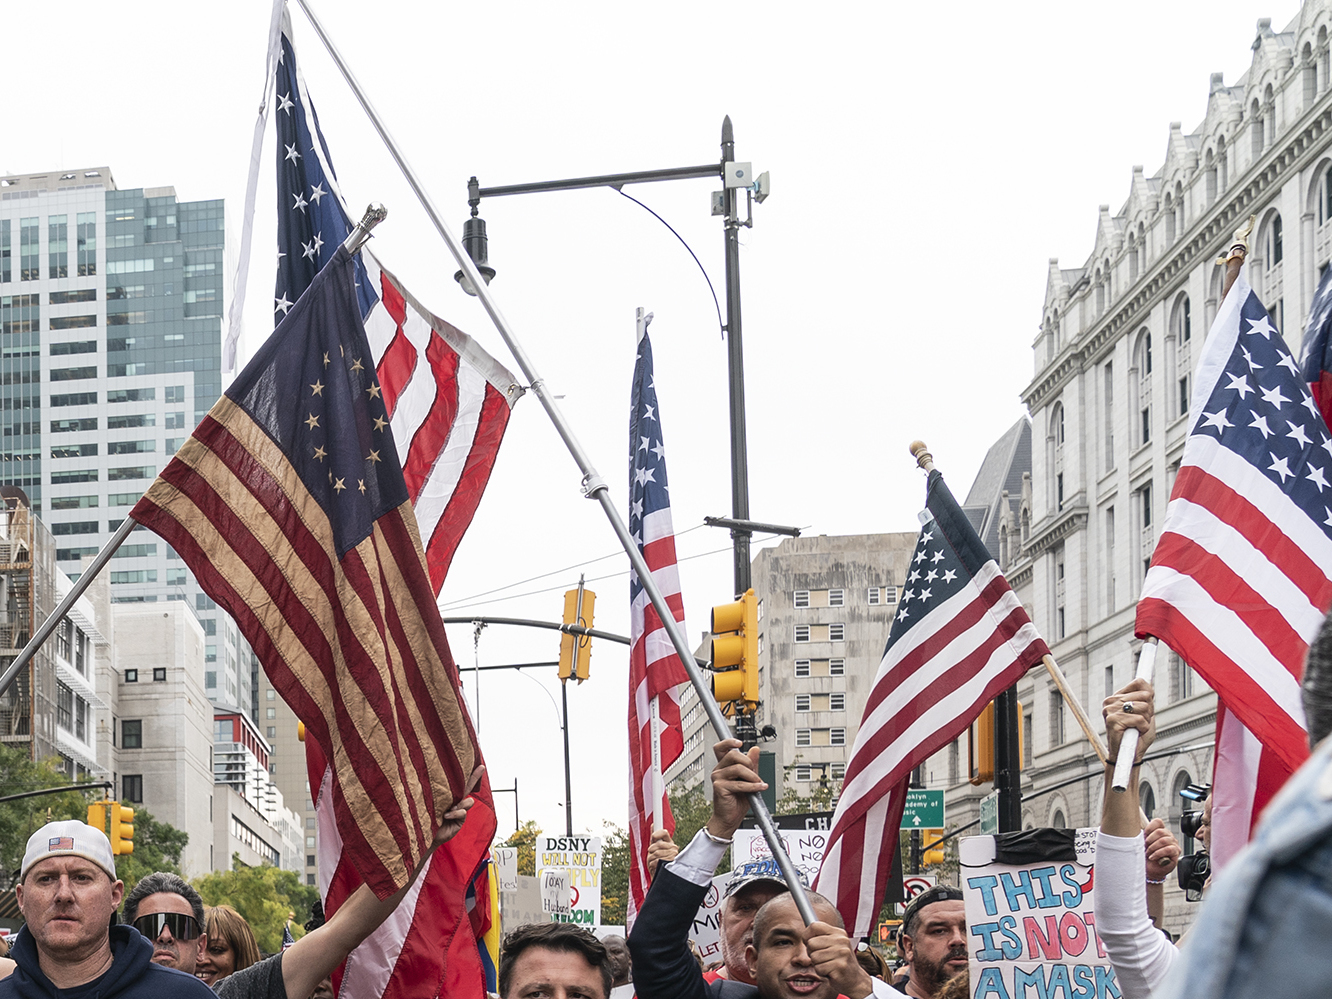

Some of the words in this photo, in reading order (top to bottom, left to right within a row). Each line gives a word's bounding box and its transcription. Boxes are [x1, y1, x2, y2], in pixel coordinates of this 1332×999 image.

[546, 838, 591, 851] DSNY
[542, 853, 569, 866] WILL
[573, 853, 596, 866] NOT
[741, 858, 786, 878] FDN
[967, 864, 1083, 916] THIS
[970, 915, 1023, 962] IS
